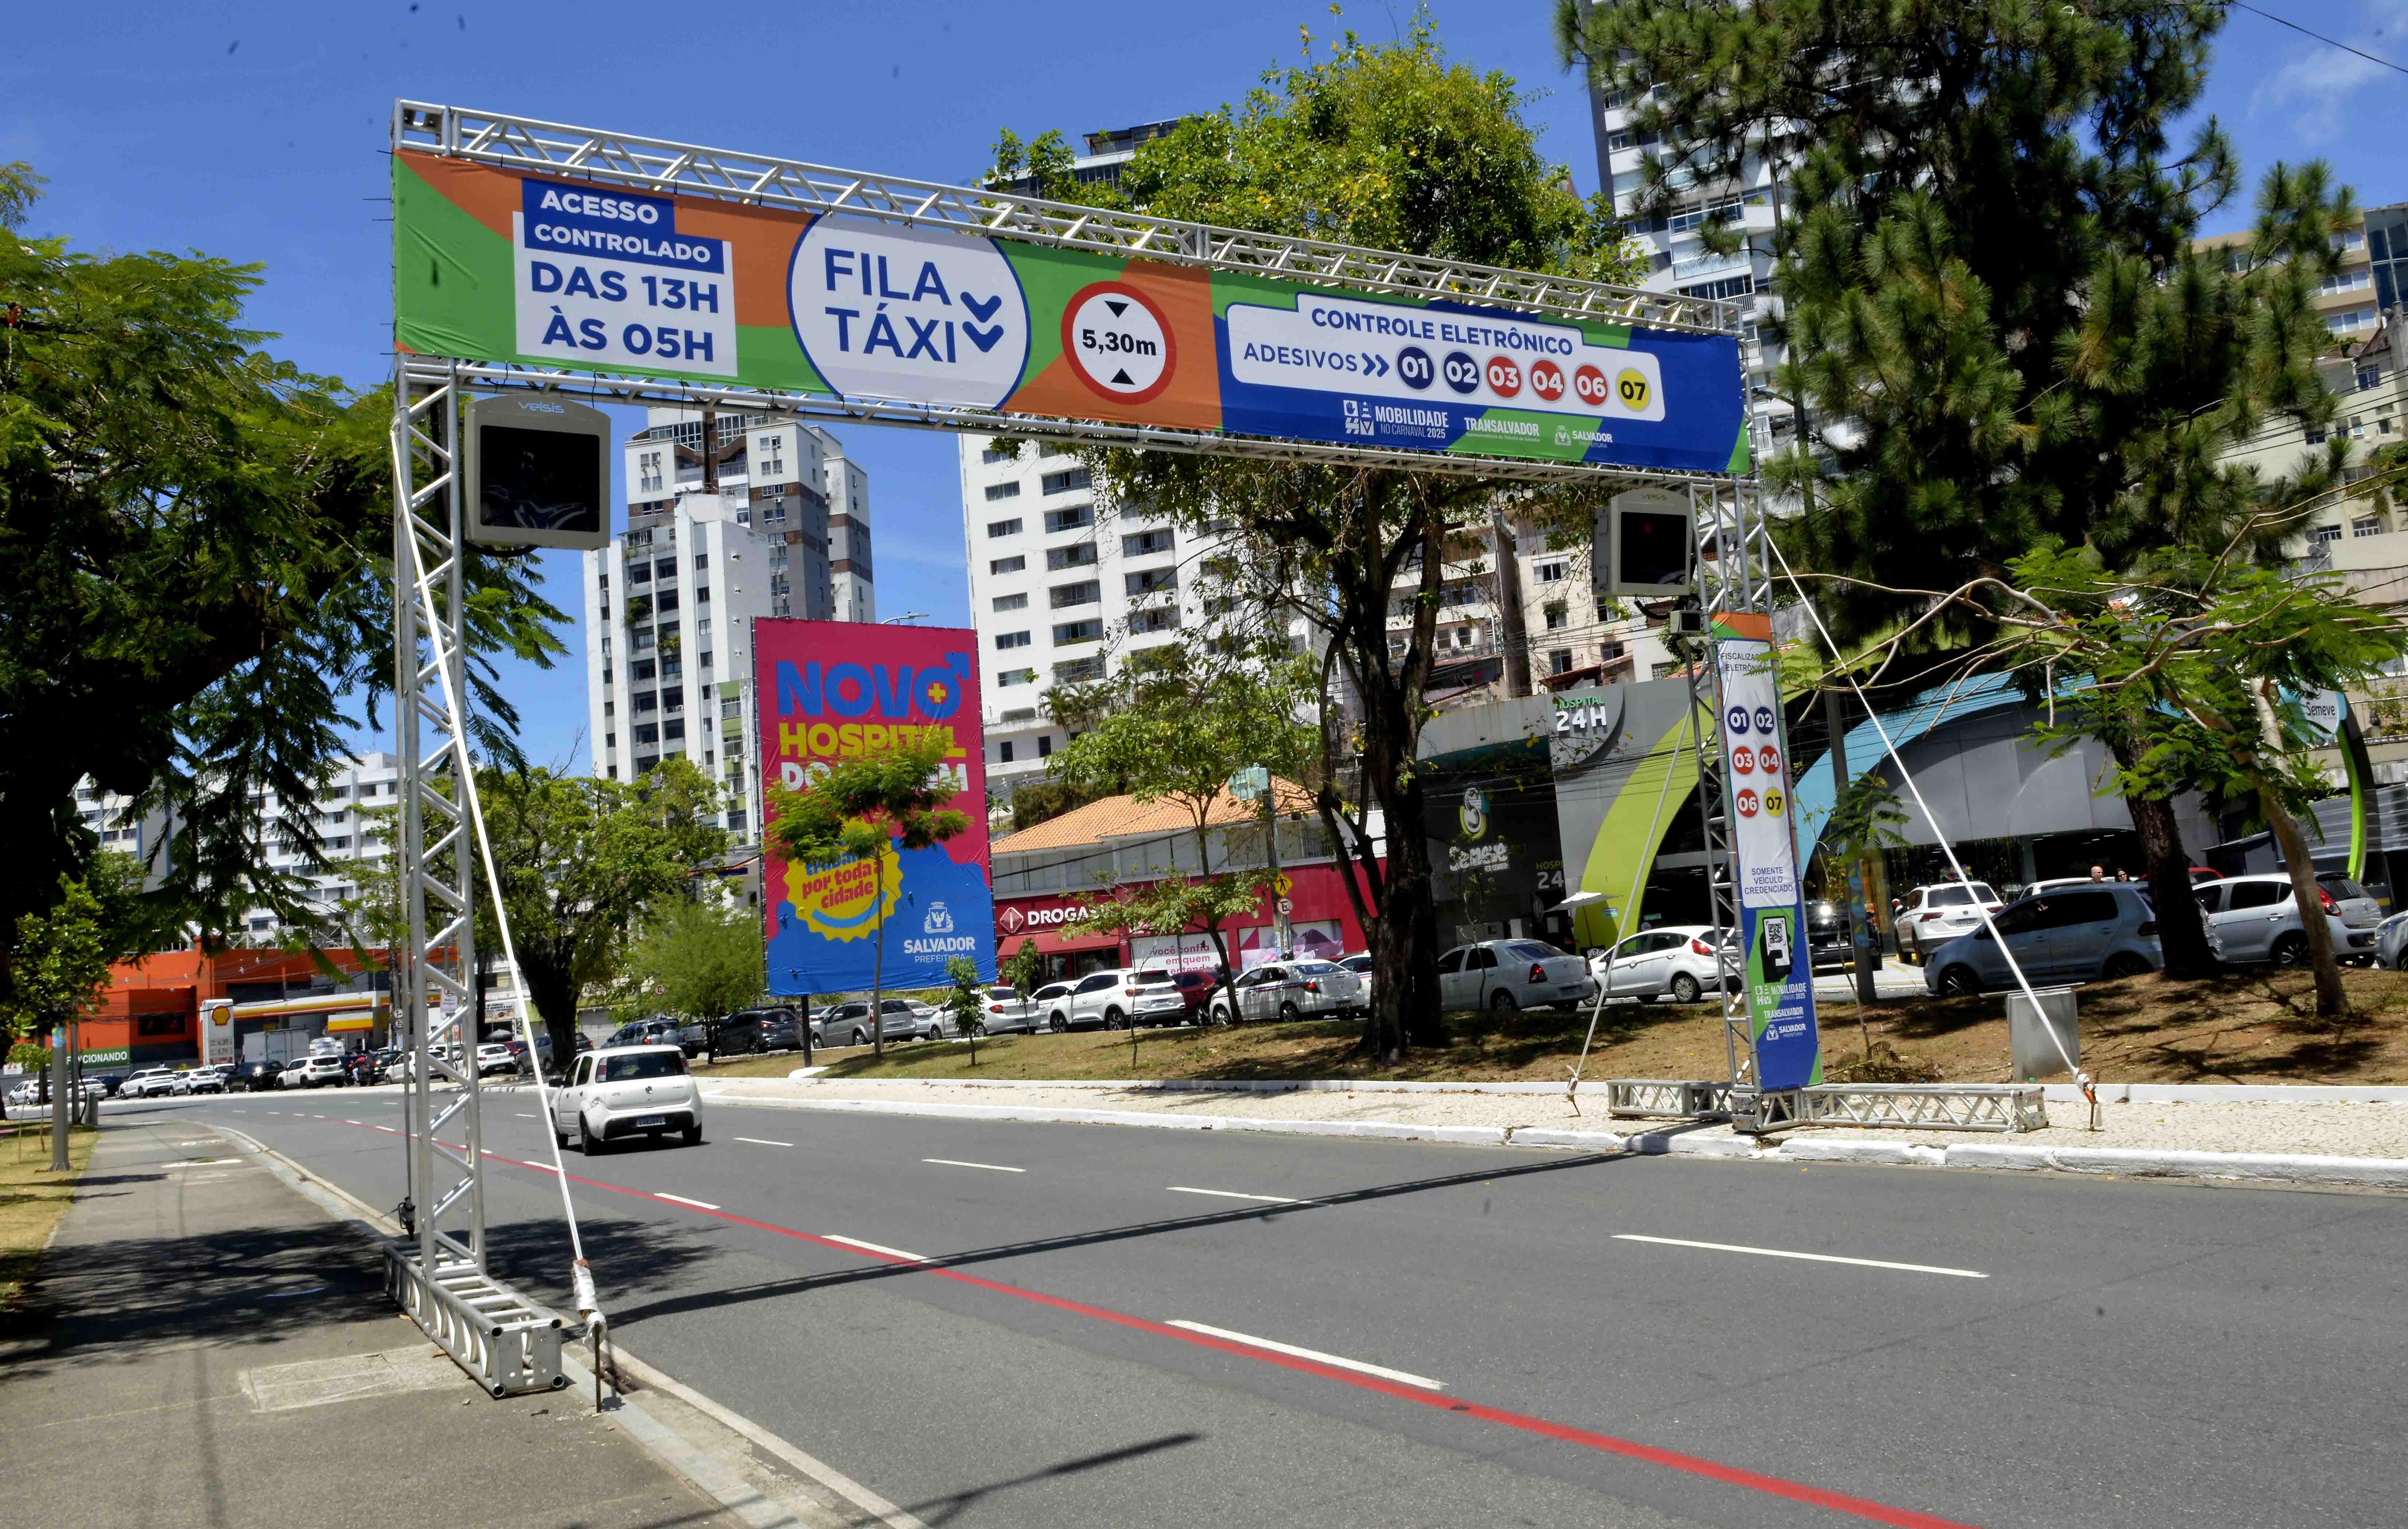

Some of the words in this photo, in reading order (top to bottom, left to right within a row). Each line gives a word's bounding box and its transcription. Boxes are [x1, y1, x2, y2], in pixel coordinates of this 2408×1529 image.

[540, 190, 659, 224] ACESSO
[535, 224, 710, 263] CONTROLADO
[825, 248, 952, 306] FILA
[531, 261, 627, 301] DAS
[642, 276, 718, 313] 13H
[541, 305, 607, 350] ÀS
[623, 324, 714, 362] 05H
[825, 302, 956, 363] TÁXI
[1312, 308, 1436, 341] CONTROLE
[1441, 324, 1573, 356] ELETRÔNICO
[1082, 328, 1157, 356] 5,30m
[1243, 342, 1358, 372] ADESIVOS
[1402, 357, 1429, 378] 01
[1445, 363, 1478, 384] 02
[1488, 368, 1519, 388] 03
[1532, 372, 1564, 392] 04
[1576, 376, 1606, 397] 06
[1620, 380, 1646, 401] 07
[517, 400, 564, 414] velsis
[1375, 406, 1449, 428] MOBILIDADE
[1380, 423, 1391, 434] NO
[1391, 424, 1426, 437] CARNAVAL
[1427, 427, 1446, 438] 2025
[1464, 417, 1539, 436] TRANSALVADOR
[1572, 431, 1613, 443] SALVADOR
[1721, 652, 1762, 661] FISCALIZA
[777, 657, 964, 719] NOVO
[2306, 702, 2335, 716] Semeve
[1556, 706, 1607, 731] 24H
[1730, 713, 1747, 728] 01
[1756, 713, 1774, 728] 02
[1735, 753, 1753, 768] 03
[1760, 753, 1779, 767] 04
[1738, 797, 1757, 812] 06
[1767, 796, 1782, 811] 07
[1751, 867, 1783, 876] SOMENTE
[802, 875, 831, 900] por
[834, 862, 871, 886] toda
[1753, 875, 1783, 885] VEÍCULO
[821, 880, 874, 909] cidade
[1744, 885, 1793, 895] CREDENCIADO
[904, 936, 976, 954] SALVADOR
[1152, 945, 1176, 956] você
[914, 953, 966, 963] PREFEITURA
[1166, 958, 1181, 966] em
[1183, 955, 1210, 965] quem
[1771, 983, 1807, 995] MOBILIDADE
[1763, 1006, 1804, 1019] TRANSALVADOR
[1778, 1023, 1807, 1033] SALVADOR
[66, 1051, 128, 1065] FCIONANDO
